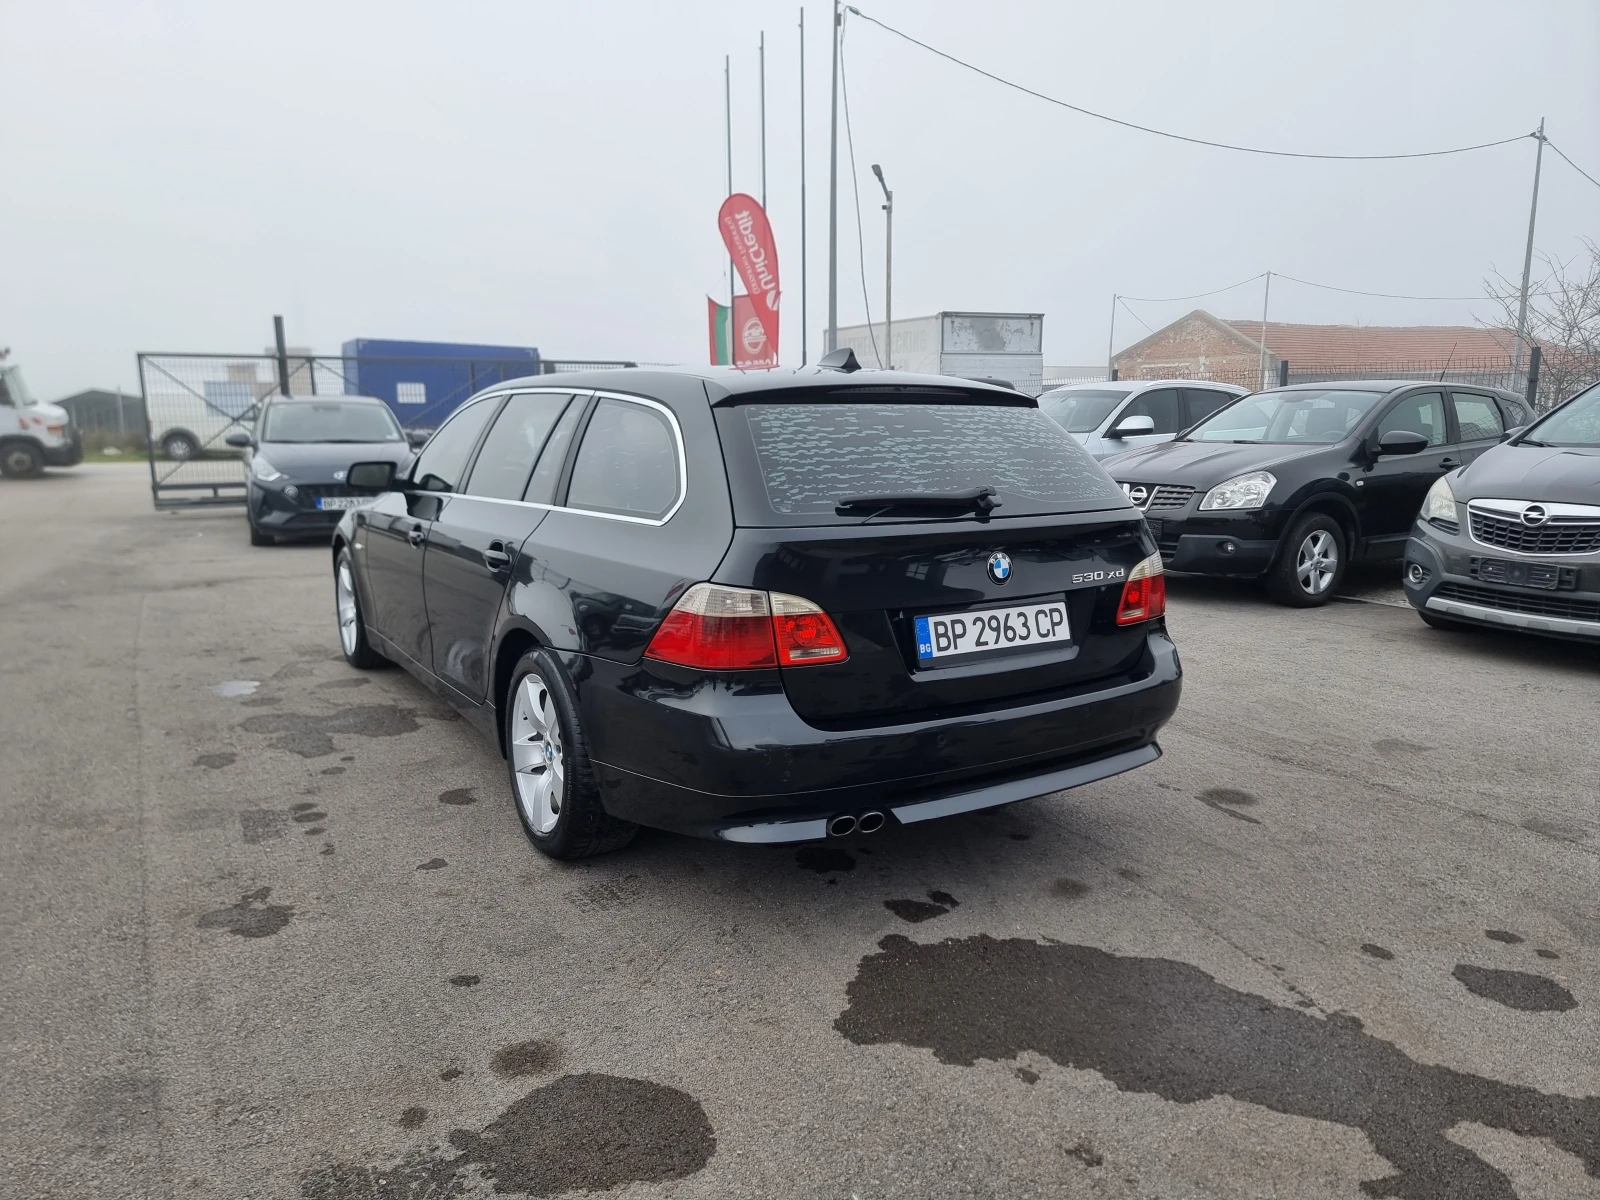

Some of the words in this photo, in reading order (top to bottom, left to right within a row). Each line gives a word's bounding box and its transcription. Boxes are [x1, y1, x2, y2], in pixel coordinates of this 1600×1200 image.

[1071, 570, 1104, 584] 530
[1106, 568, 1125, 580] xd
[933, 618, 967, 652] BP
[972, 611, 1031, 648] 2963
[1034, 607, 1064, 638] CP
[919, 643, 931, 654] BG
